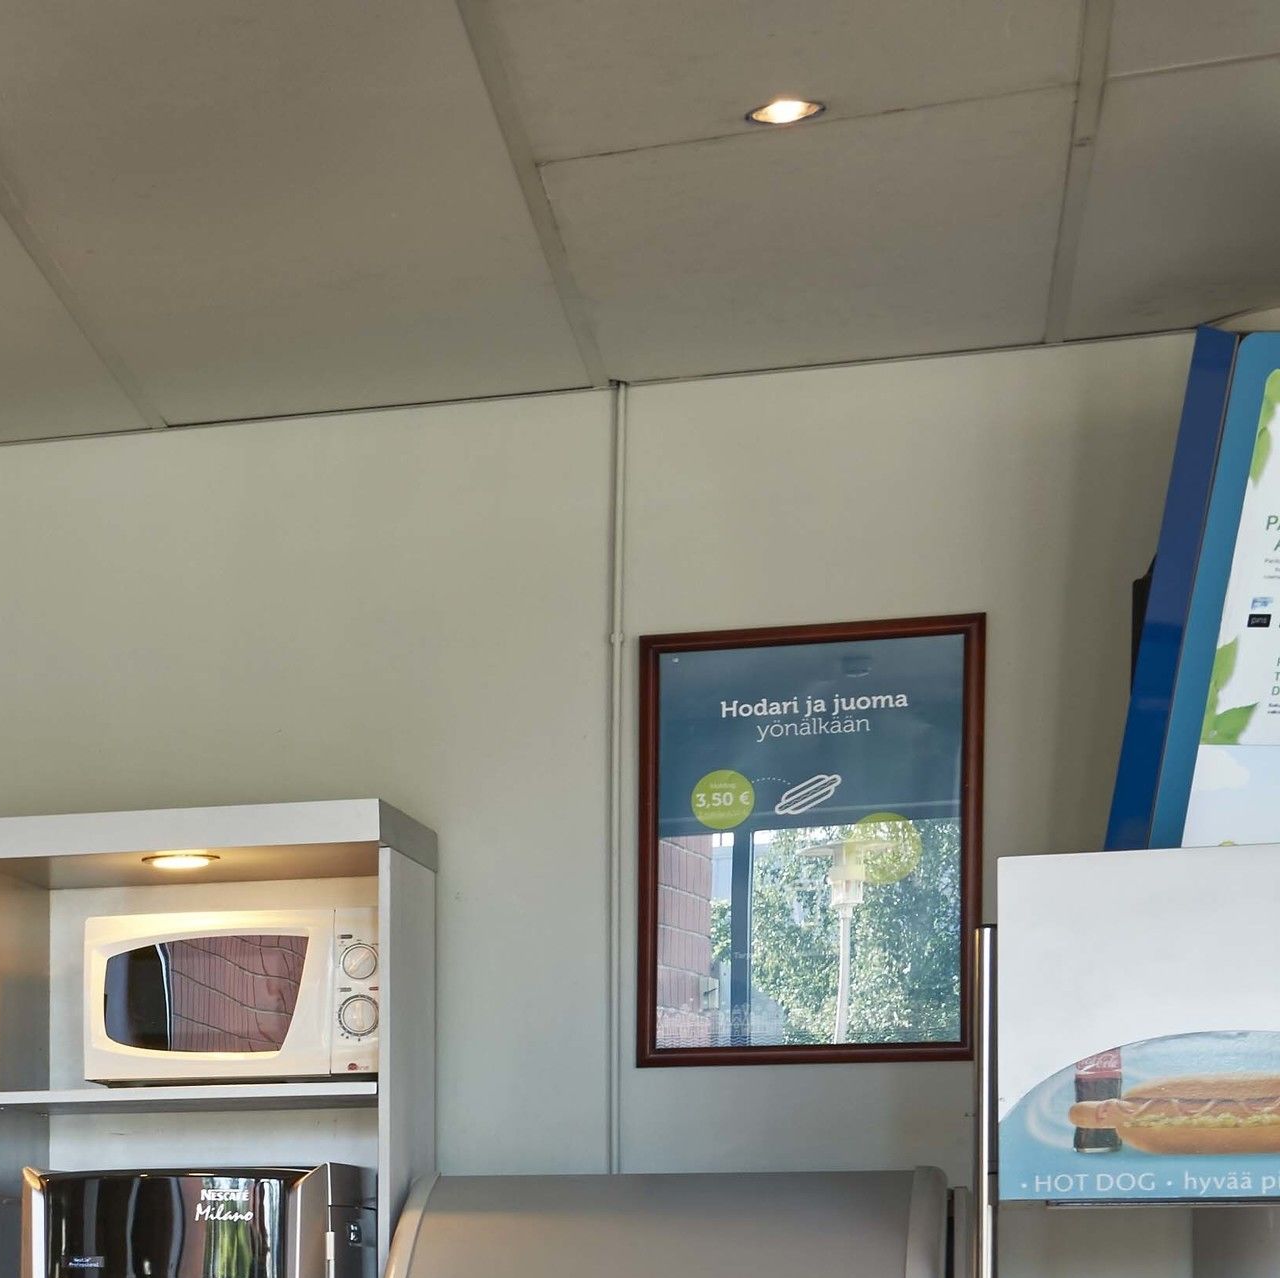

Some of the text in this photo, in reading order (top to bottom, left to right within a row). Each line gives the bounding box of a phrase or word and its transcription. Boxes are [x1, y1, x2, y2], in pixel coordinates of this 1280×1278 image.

[720, 693, 908, 719] Hodari ja juoma
[756, 715, 871, 742] yönälkään
[695, 791, 750, 809] 3,50 €
[1035, 1172, 1252, 1195] HOT DOG hyvää
[194, 1203, 254, 1222] Milano
